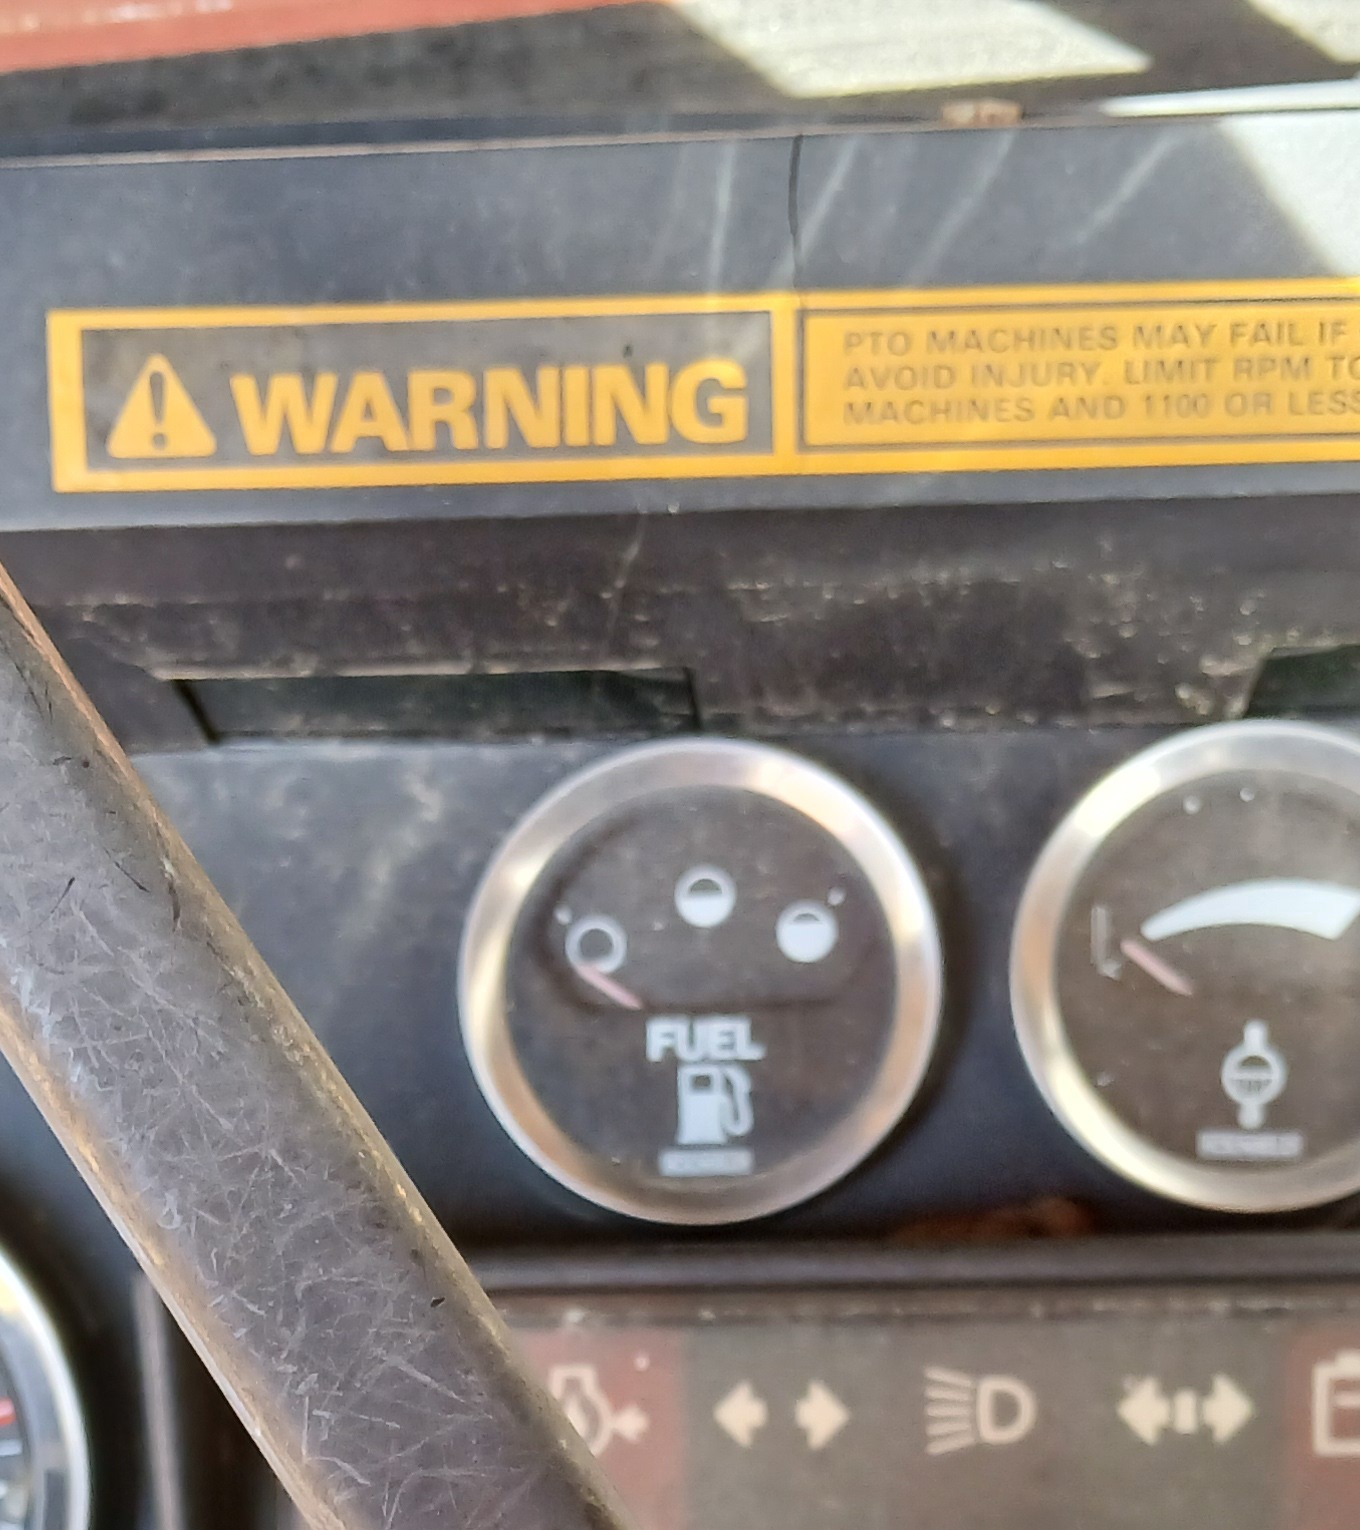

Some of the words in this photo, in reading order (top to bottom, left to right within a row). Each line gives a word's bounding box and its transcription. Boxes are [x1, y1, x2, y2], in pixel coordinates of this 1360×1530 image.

[844, 331, 913, 356] PTO
[927, 325, 1117, 354] MACHINES
[1133, 323, 1217, 347] MAY
[1230, 320, 1304, 346] FAIL
[1318, 320, 1348, 345] IF
[846, 364, 956, 391] AVOID
[1124, 356, 1221, 385] LIMIT
[1233, 355, 1312, 382] RPM
[230, 359, 749, 455] WARNING
[843, 397, 1036, 425] MACHINES
[1049, 393, 1126, 420] AND
[1144, 393, 1210, 419] 1100
[1225, 391, 1273, 418] OR
[645, 1014, 767, 1062] FUEL
